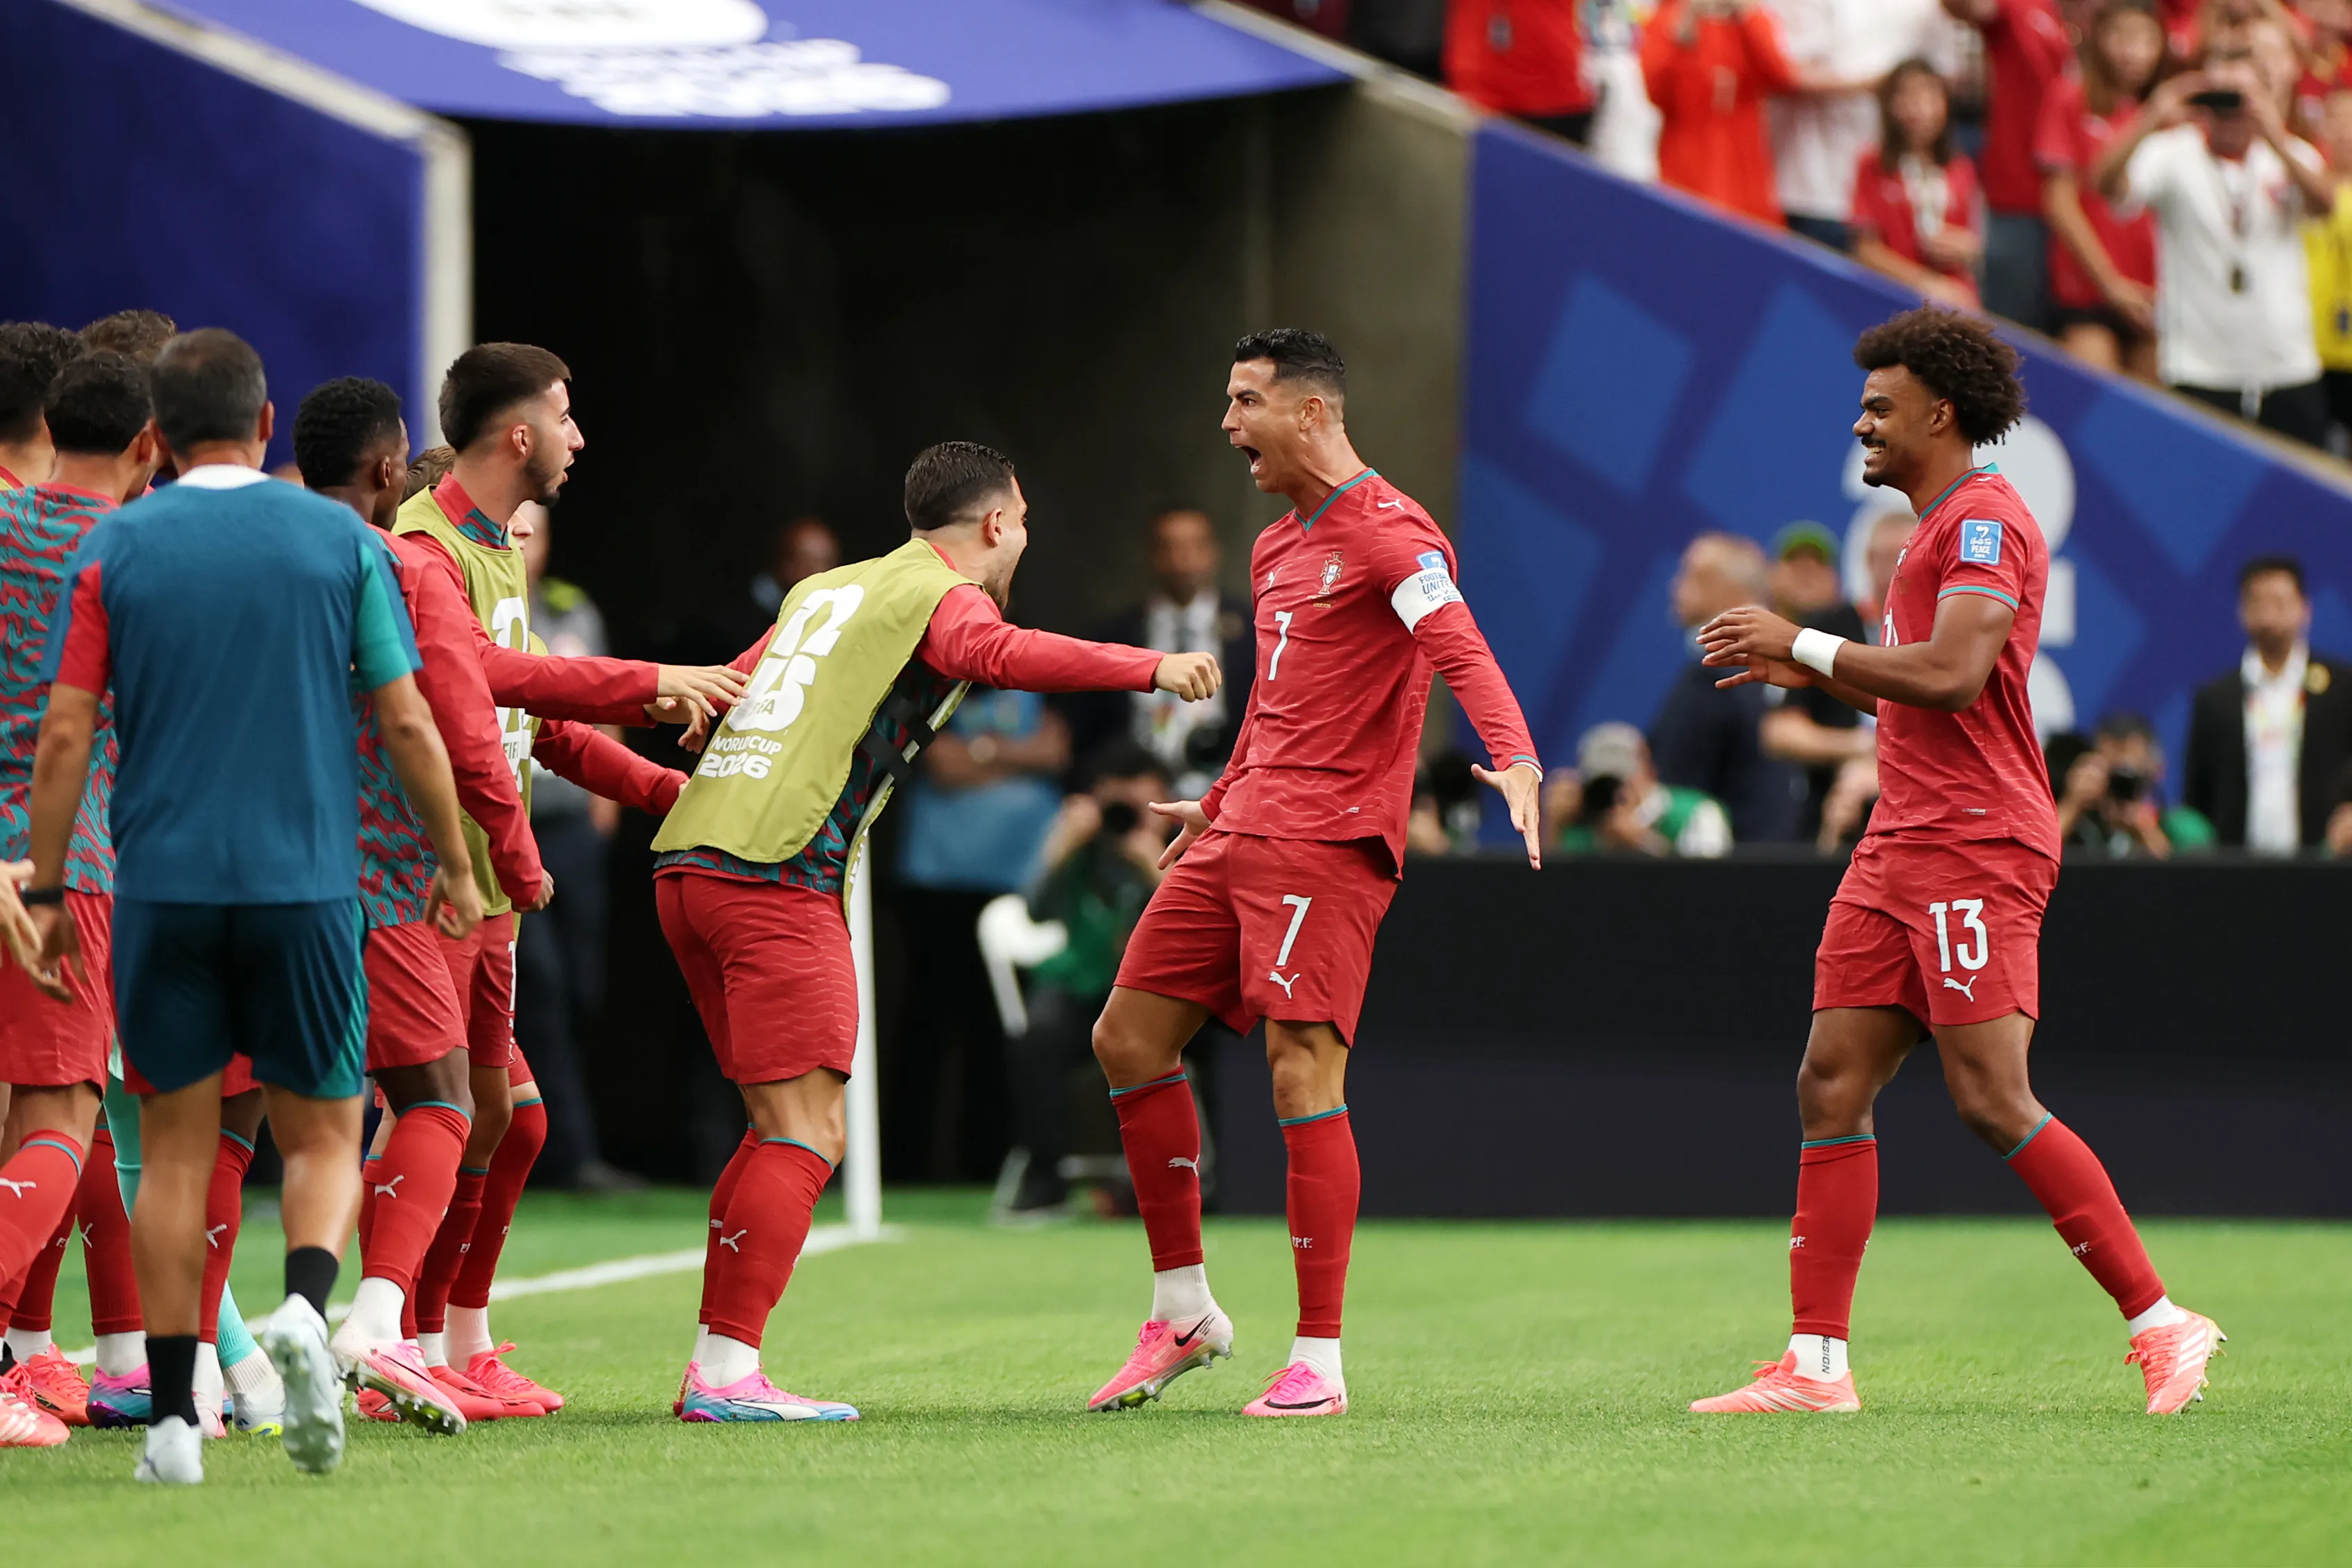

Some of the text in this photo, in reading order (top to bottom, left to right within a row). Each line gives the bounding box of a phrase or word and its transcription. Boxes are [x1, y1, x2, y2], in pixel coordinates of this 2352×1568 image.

[1267, 610, 1293, 681] 7
[697, 752, 772, 779] 2026
[1276, 894, 1312, 966] 7
[1929, 898, 1988, 972] 13
[1821, 1336, 1830, 1374] ESIGN
